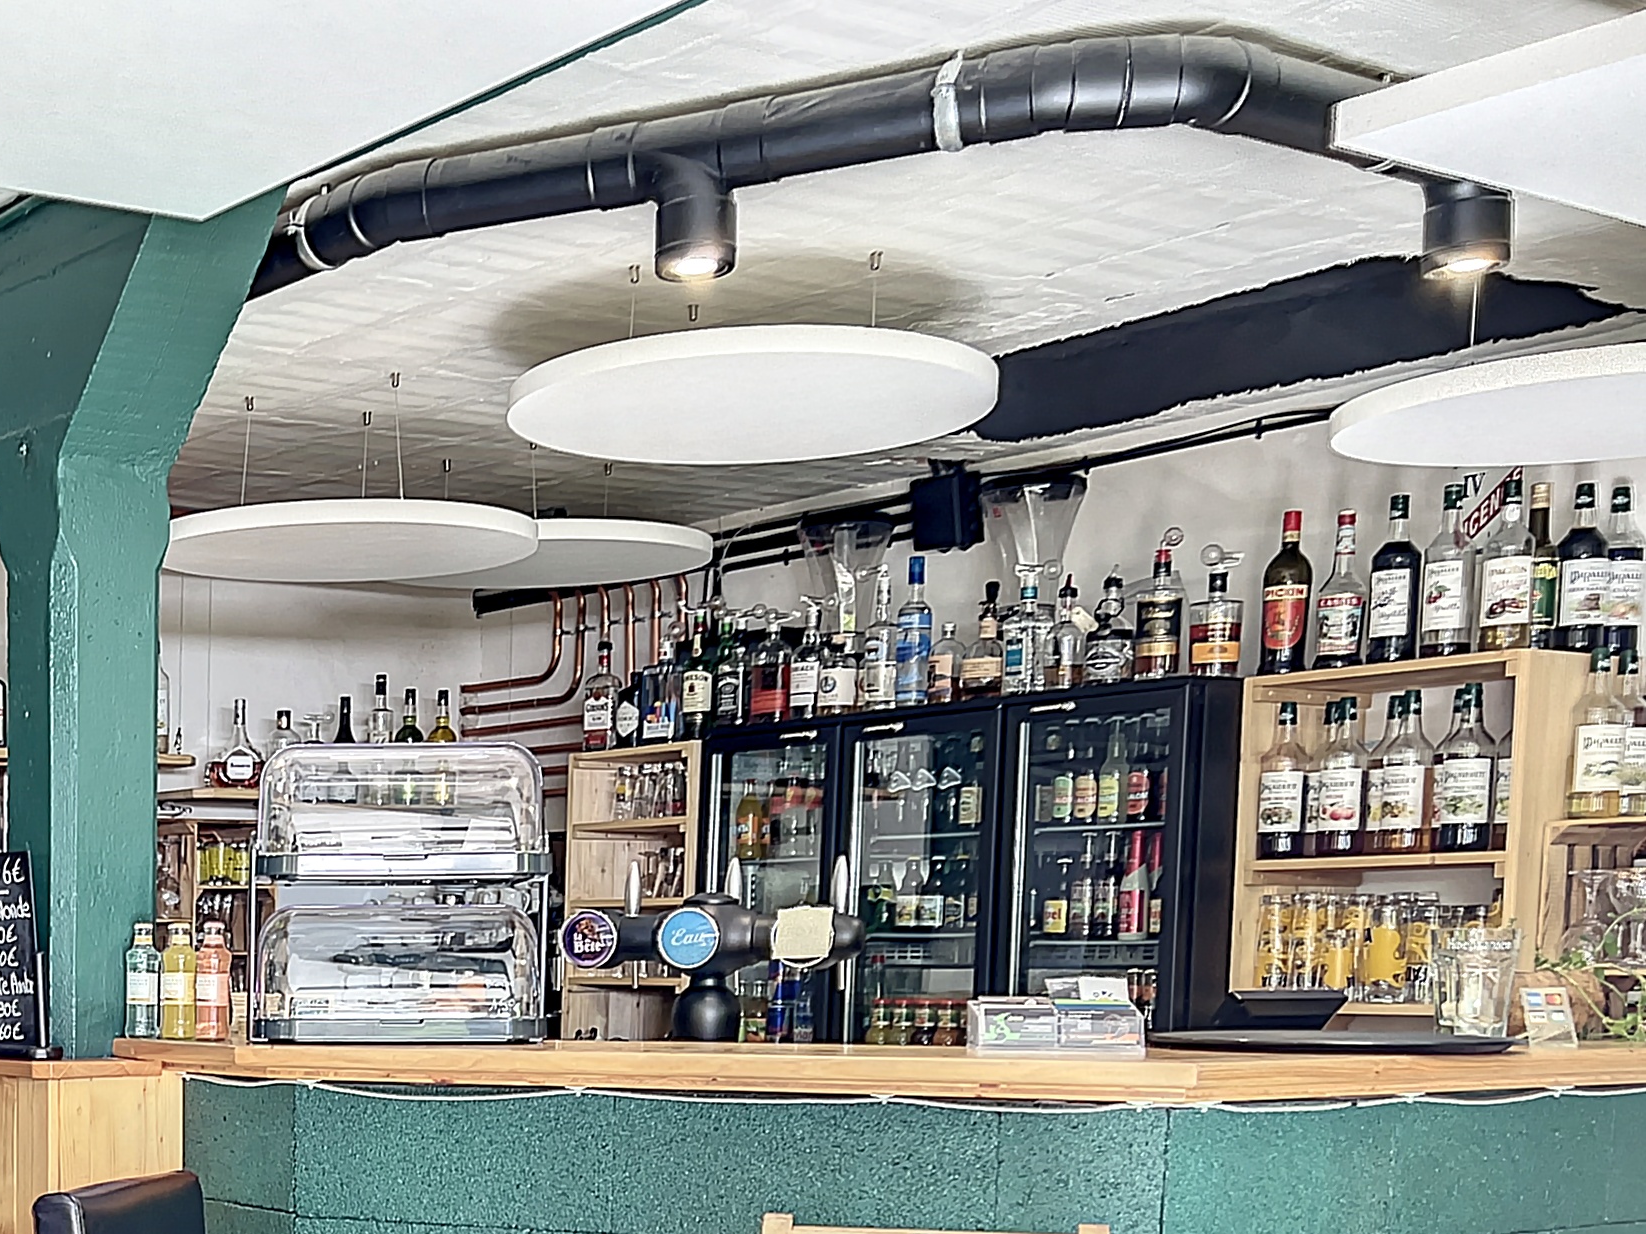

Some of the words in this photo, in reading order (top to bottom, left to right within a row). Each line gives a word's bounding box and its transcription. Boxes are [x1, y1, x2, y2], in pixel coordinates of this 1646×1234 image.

[1464, 472, 1485, 498] IV
[1265, 588, 1304, 598] PICON
[3, 856, 25, 884] 6€
